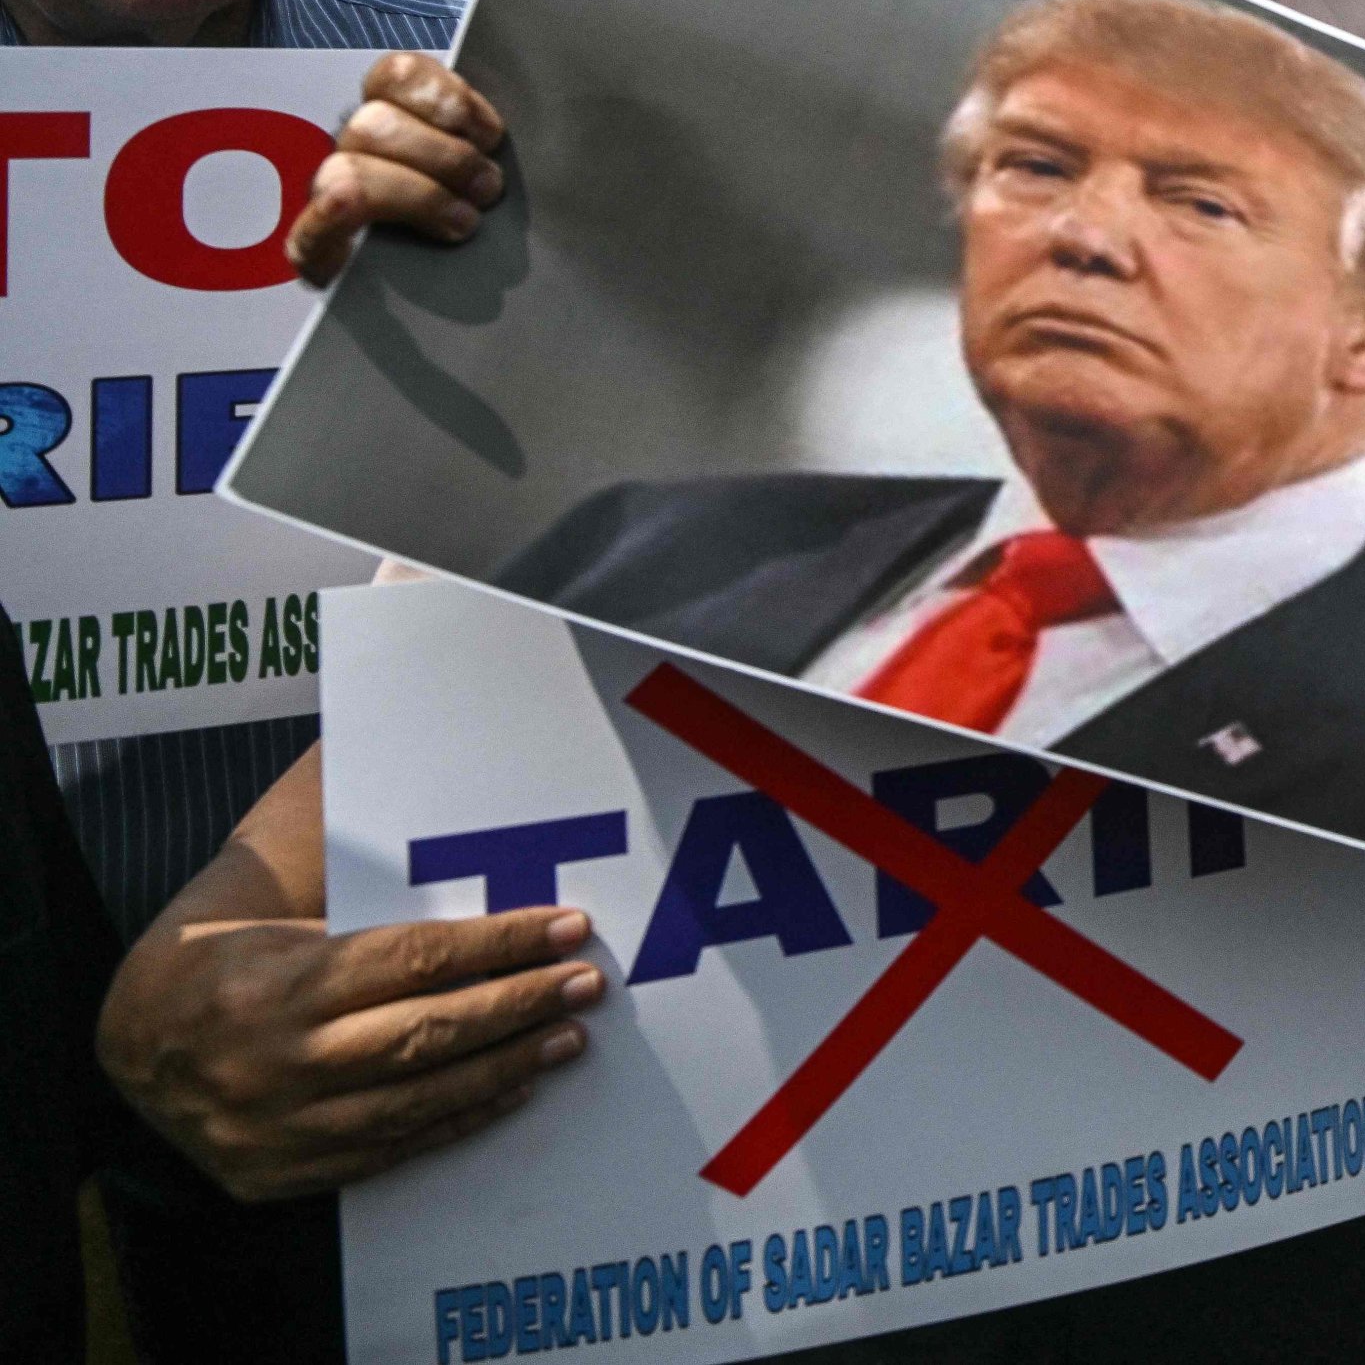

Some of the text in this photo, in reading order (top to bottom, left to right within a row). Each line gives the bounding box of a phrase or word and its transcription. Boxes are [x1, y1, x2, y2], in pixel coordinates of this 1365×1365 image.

[12, 615, 101, 704] ZAR
[112, 599, 250, 695] TRADES
[434, 1251, 689, 1364] FEDERATION
[701, 1240, 752, 1325] OF
[764, 1213, 890, 1315] SADAR
[901, 1183, 1023, 1286] BAZAR
[1031, 1150, 1168, 1257] TRADES
